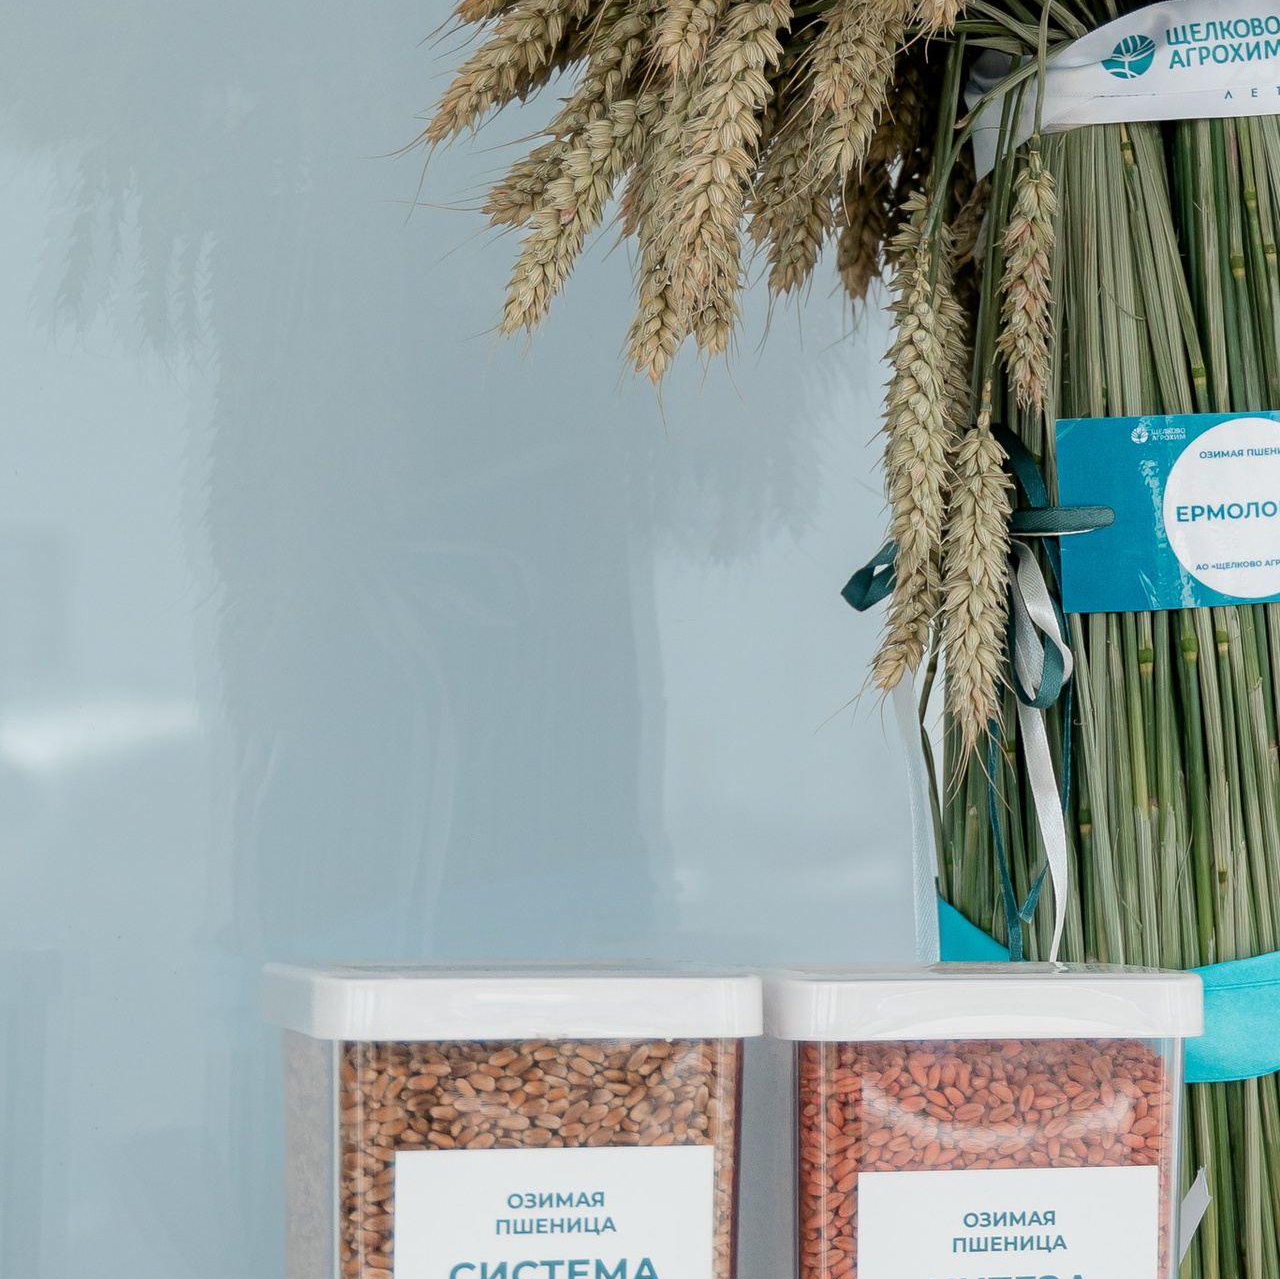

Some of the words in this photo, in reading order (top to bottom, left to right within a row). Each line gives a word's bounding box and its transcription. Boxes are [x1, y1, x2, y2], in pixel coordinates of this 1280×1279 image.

[1151, 427, 1186, 435] ЩЕЛКОВО
[1151, 433, 1187, 441] АГРОХИМ
[1199, 449, 1244, 459] ОЗИМАЯ
[1195, 563, 1209, 571] АО
[1211, 560, 1262, 571] «ЩЕЛКОВО
[507, 1191, 605, 1210] ОЗИМАЯ
[495, 1216, 617, 1236] ПШЕНИЦА
[963, 1210, 1056, 1228] ОЗИМАЯ
[952, 1234, 1068, 1253] ПШЕНИЦА
